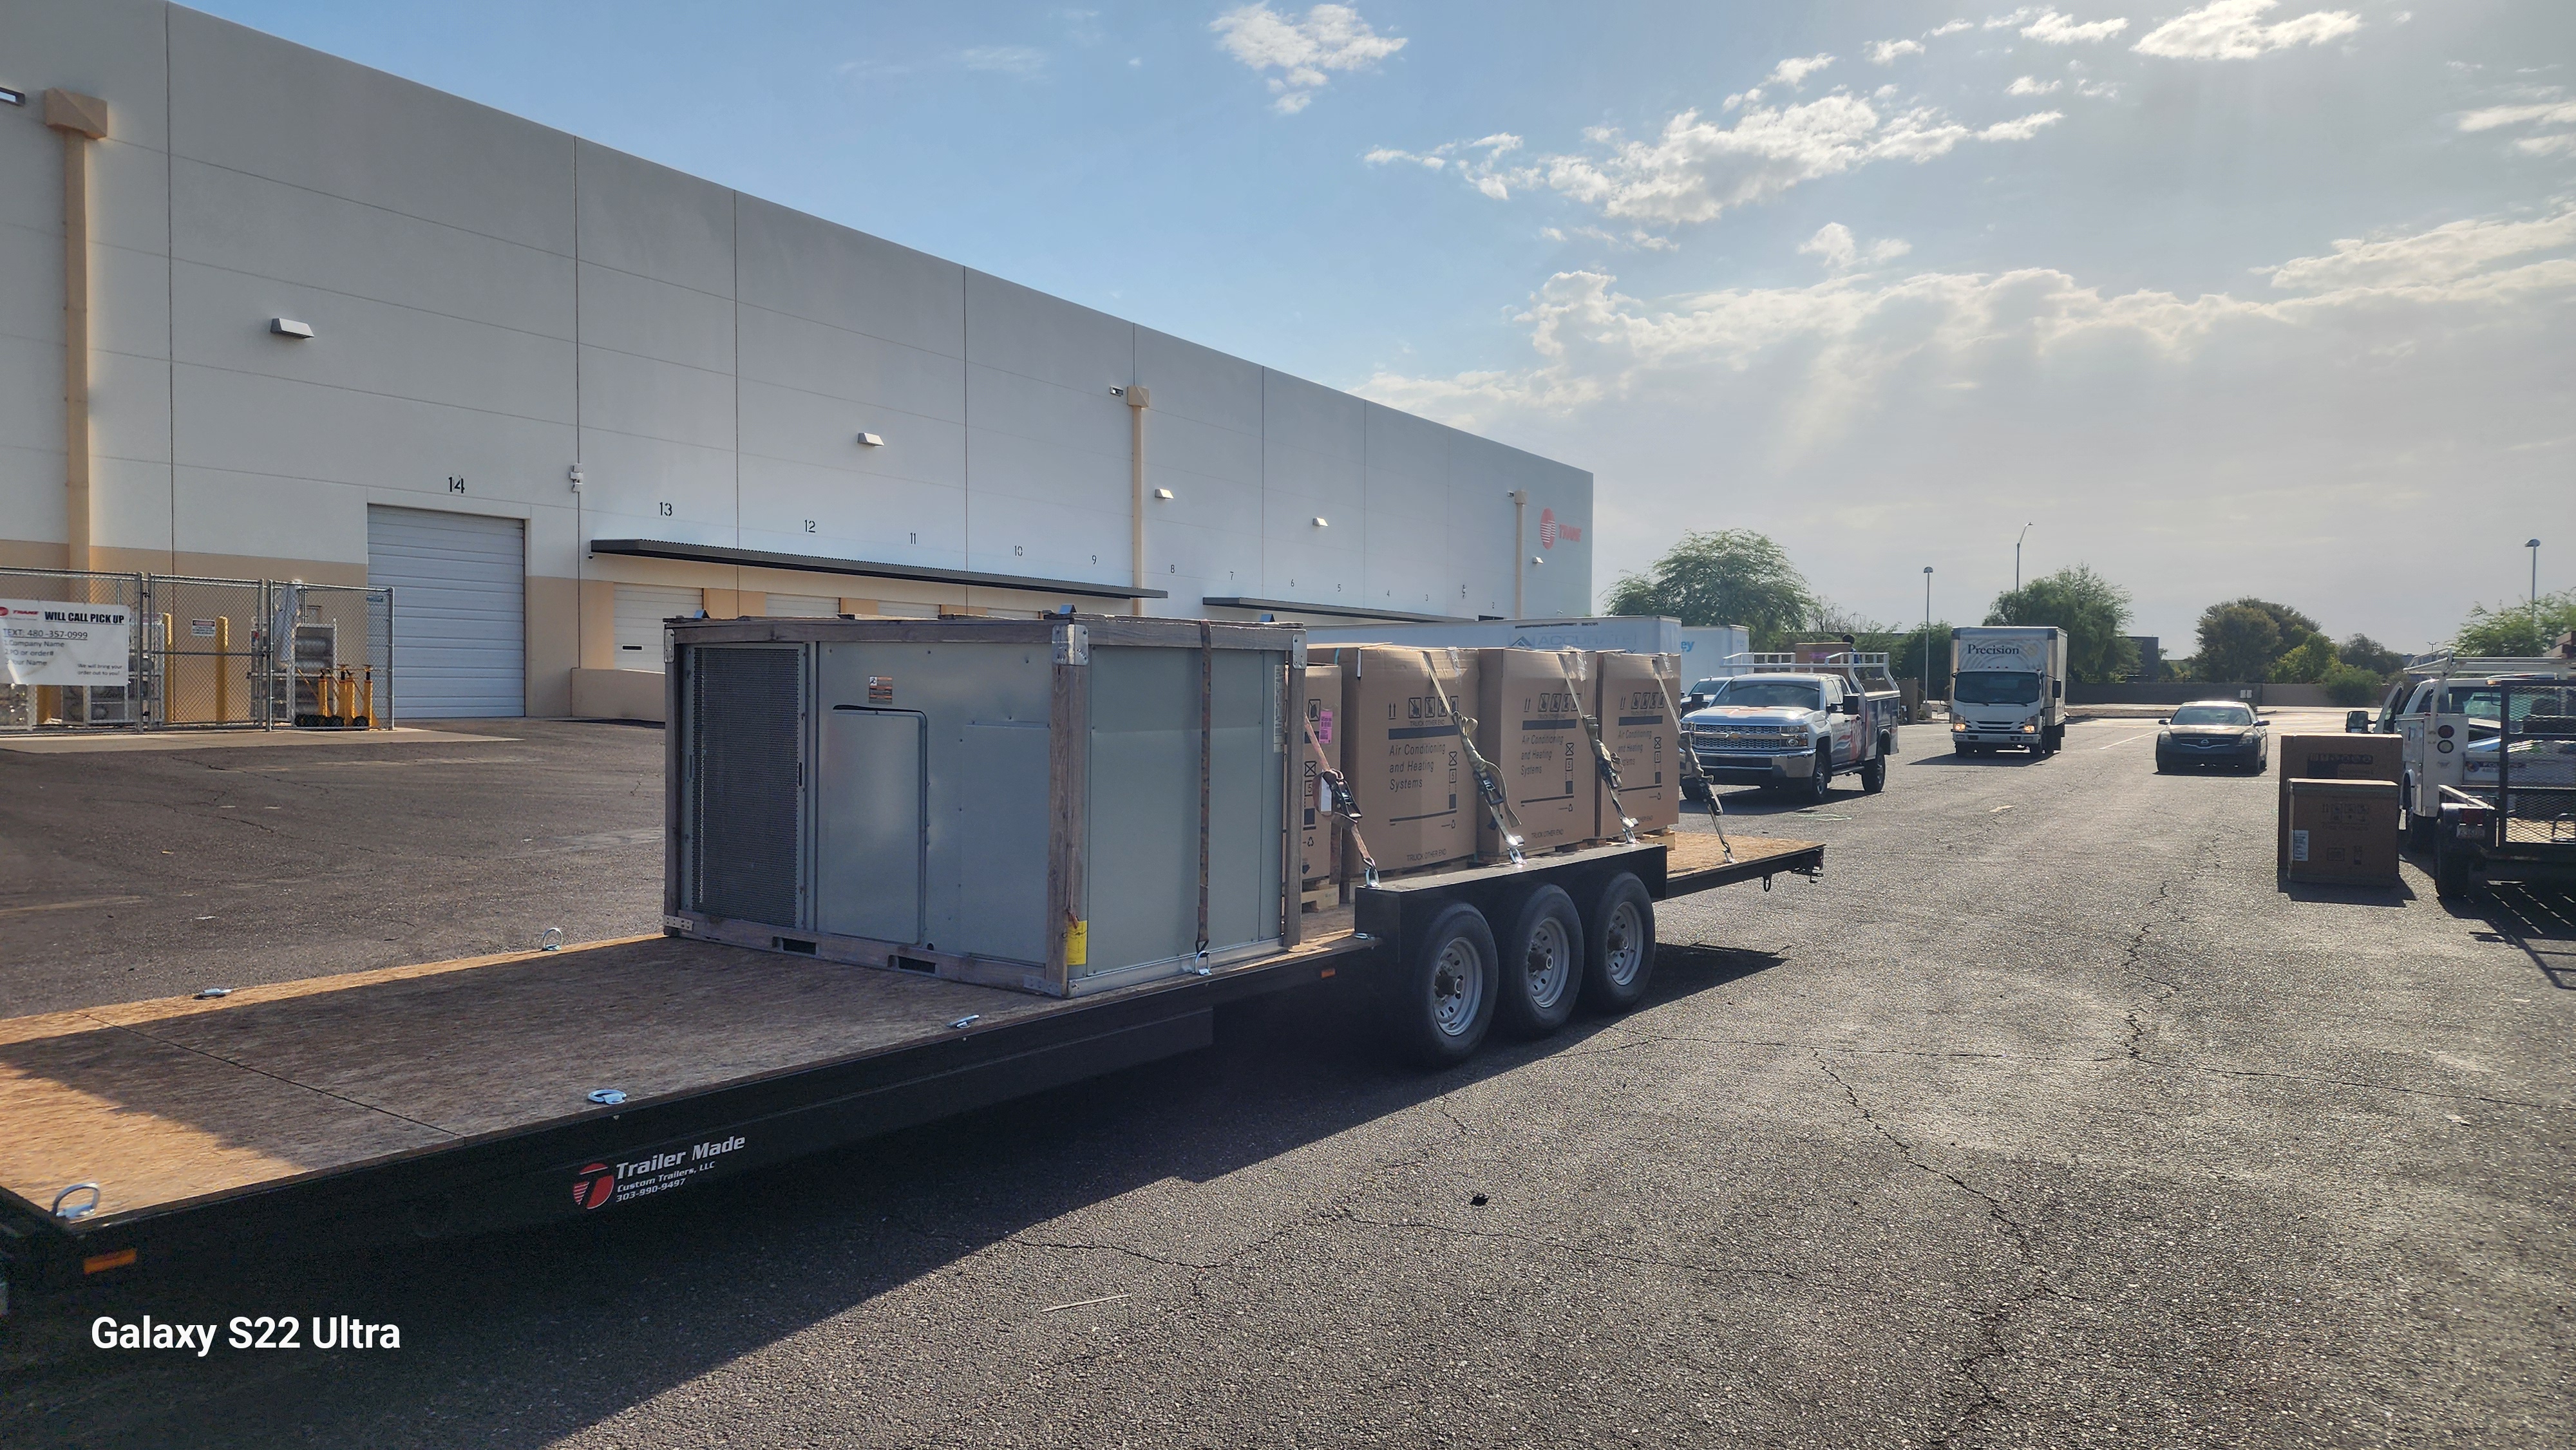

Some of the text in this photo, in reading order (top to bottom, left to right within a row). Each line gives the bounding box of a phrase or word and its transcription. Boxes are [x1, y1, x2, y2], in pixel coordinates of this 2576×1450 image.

[448, 475, 465, 494] 14
[659, 502, 672, 517] 13
[804, 519, 816, 533] 12
[909, 532, 916, 545] 11
[1014, 545, 1023, 557] 10
[1092, 554, 1097, 565] 9
[1170, 564, 1175, 574] 8
[1229, 570, 1234, 581] 7
[1291, 578, 1294, 587] 6
[1338, 583, 1341, 592] 5
[1425, 594, 1428, 602] 3
[45, 611, 124, 624] WILL CALL PICK UP
[1968, 644, 2019, 655] Precision
[1389, 742, 1446, 757] Air Conditioning
[1389, 760, 1434, 773] and Heating
[1308, 784, 1312, 793] 5
[1390, 778, 1423, 793] Systems
[616, 1136, 745, 1180] Trailer Made
[617, 1160, 715, 1192] Custom Trailers, LLC
[616, 1178, 687, 1203] 303-990-9497
